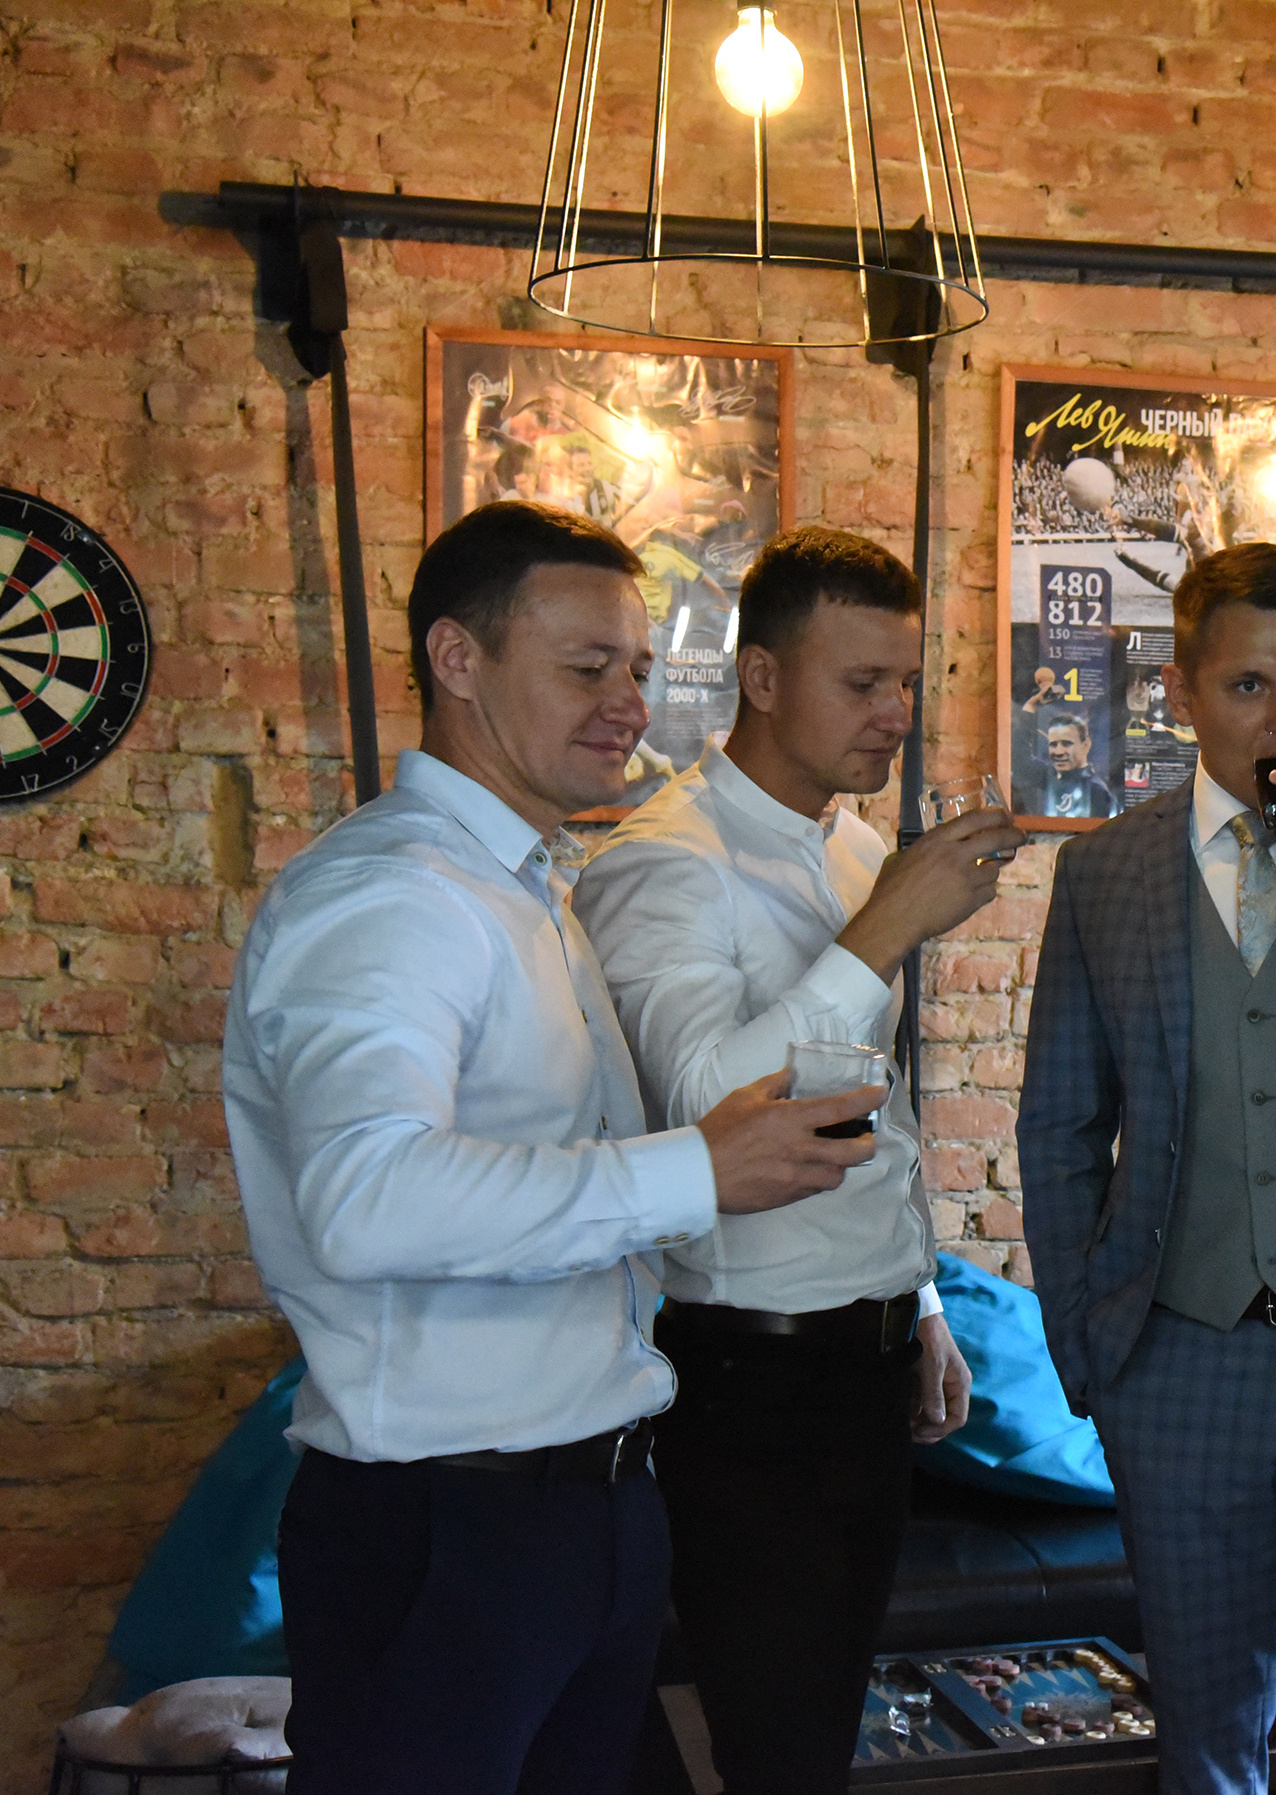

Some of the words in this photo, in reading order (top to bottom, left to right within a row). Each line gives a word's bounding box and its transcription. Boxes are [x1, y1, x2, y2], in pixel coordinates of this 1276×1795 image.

[1141, 408, 1223, 437] ЧЕРНЫЙ
[1047, 571, 1103, 597] 480
[1048, 600, 1102, 626] 812
[1049, 628, 1070, 640] 150
[666, 648, 723, 664] ЛЕГЕНДЫ
[666, 668, 724, 684] ФУТБОЛА
[1064, 668, 1083, 701] 1
